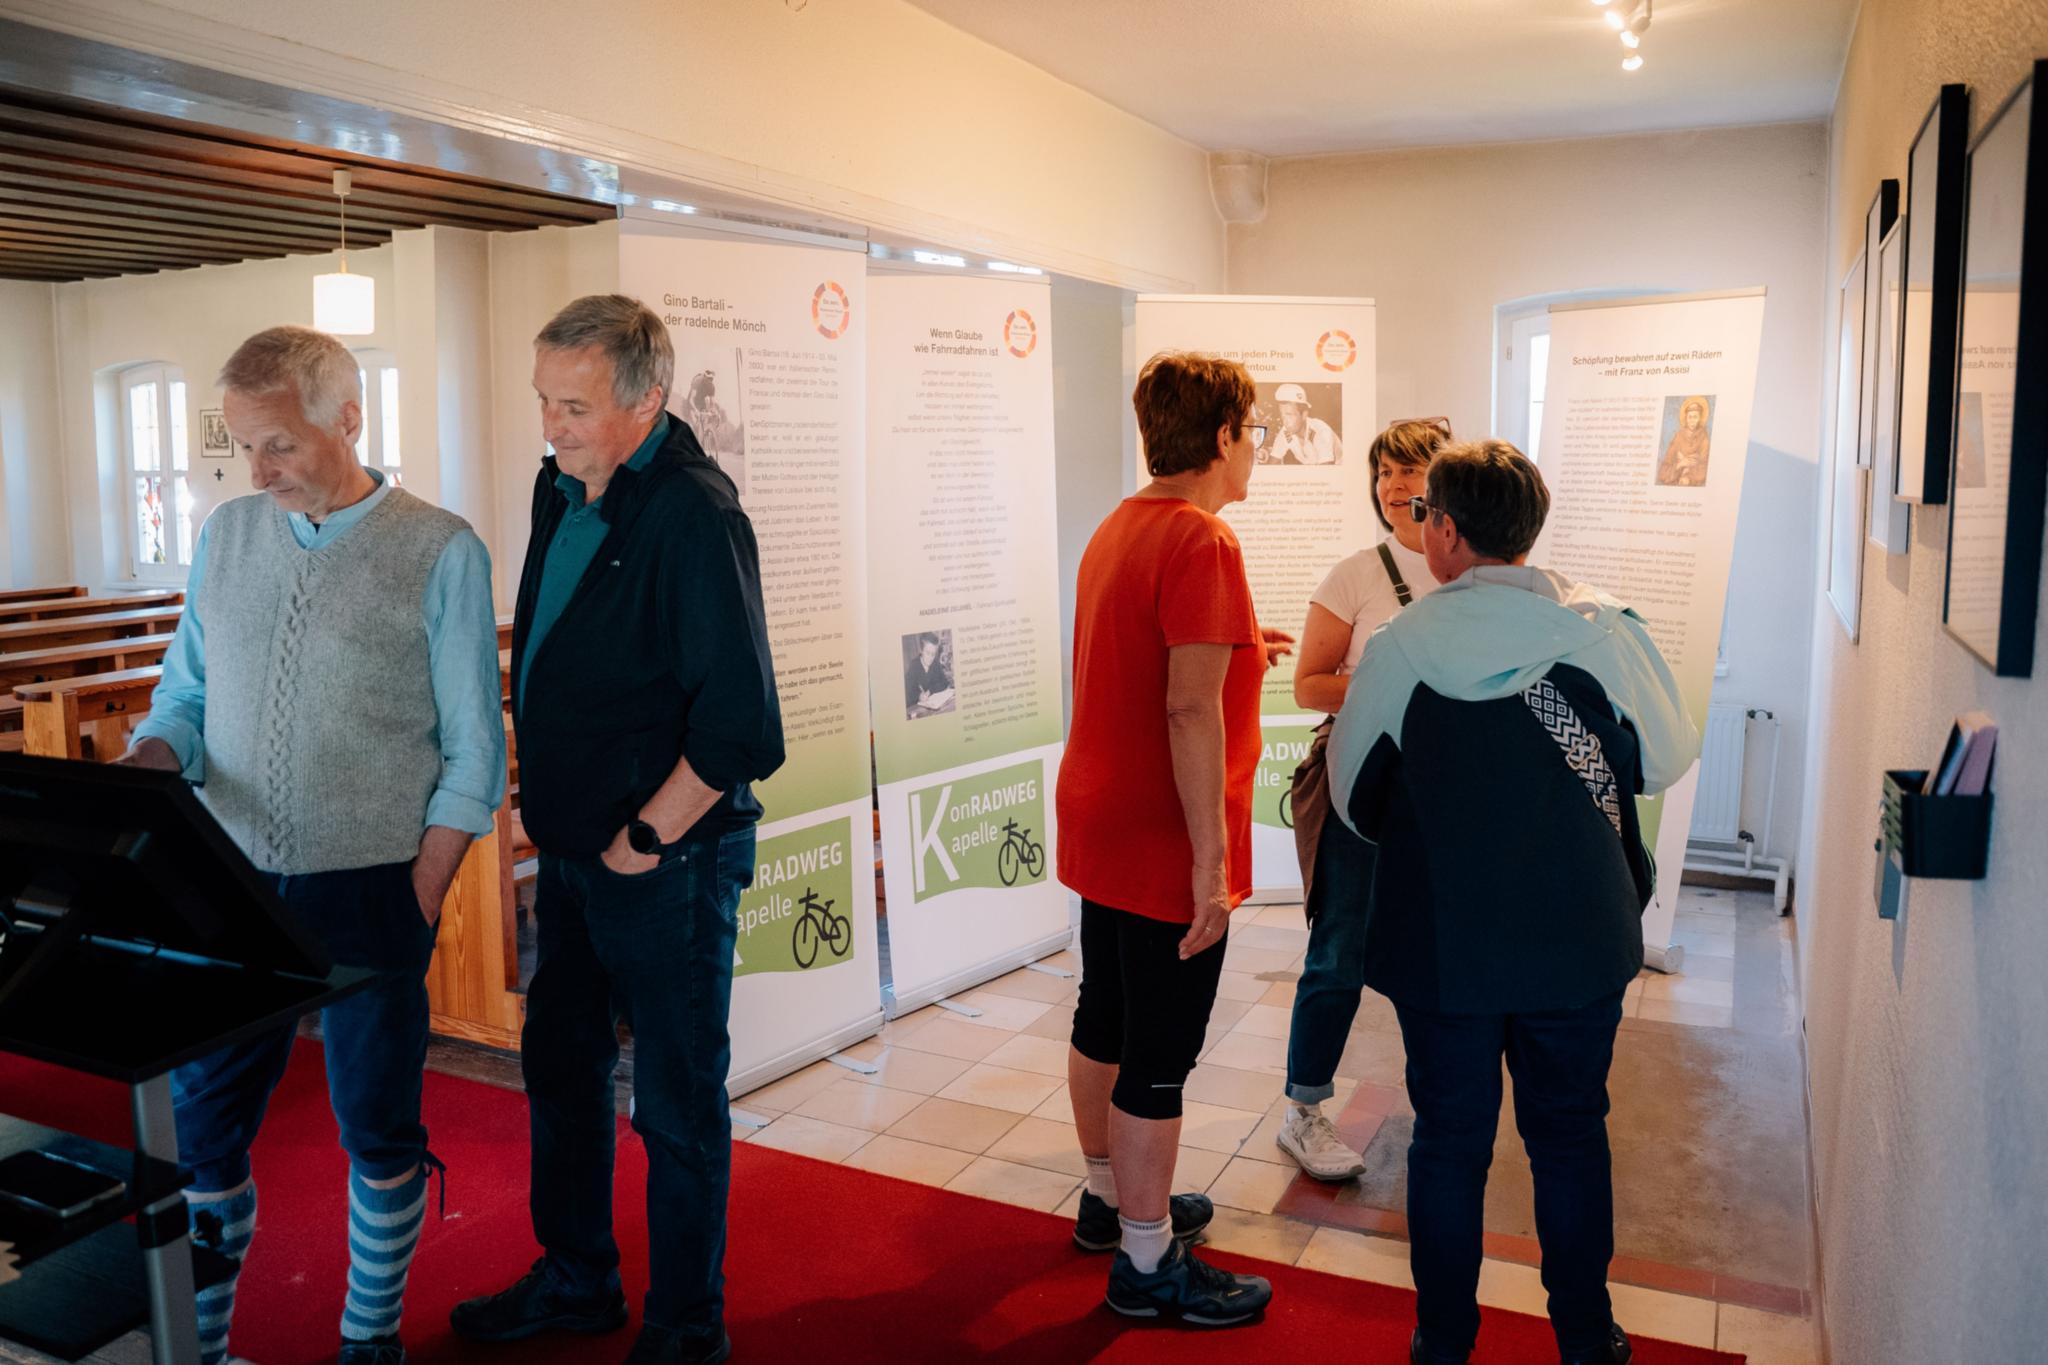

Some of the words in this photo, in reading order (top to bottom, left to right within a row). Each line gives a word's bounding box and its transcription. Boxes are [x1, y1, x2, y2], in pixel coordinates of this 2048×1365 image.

[663, 293, 689, 308] Gino
[691, 296, 725, 311] Bartali
[664, 313, 683, 326] der
[685, 315, 730, 330] radelnde
[732, 318, 767, 333] Mönch
[930, 328, 952, 340] Wenn
[955, 329, 983, 341] Glaube
[914, 344, 929, 354] wie
[931, 343, 987, 356] Fahrradfahren
[989, 347, 999, 357] ist
[1241, 350, 1267, 360] jeden
[1270, 350, 1294, 359] Preis
[1572, 356, 1613, 368] Schöpfung
[1614, 354, 1654, 364] bewahren
[1655, 352, 1669, 362] auf
[1670, 351, 1690, 361] zwei
[1691, 350, 1722, 360] Rädern
[1247, 363, 1276, 371] entoux
[1604, 367, 1618, 377] mit
[1620, 366, 1643, 377] Franz
[1645, 368, 1661, 376] von
[1663, 366, 1690, 375] Assisi
[952, 822, 999, 856] apelle
